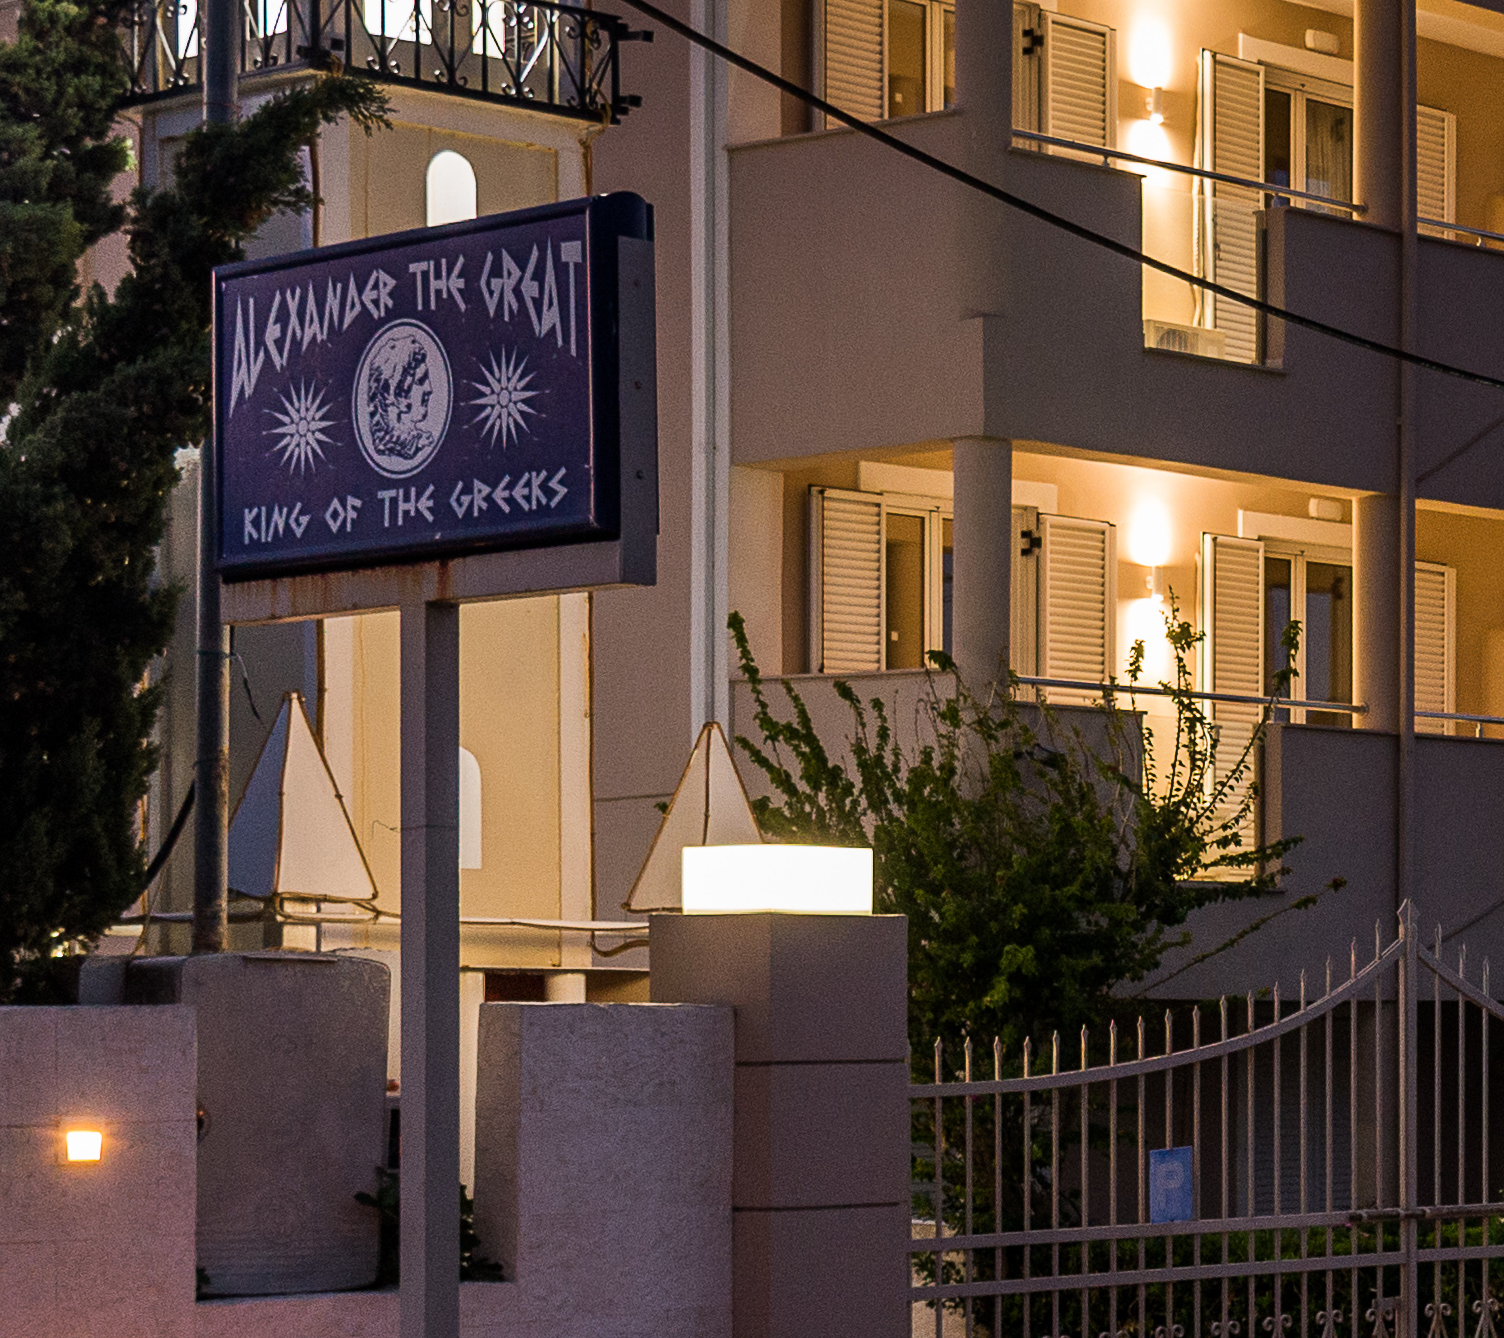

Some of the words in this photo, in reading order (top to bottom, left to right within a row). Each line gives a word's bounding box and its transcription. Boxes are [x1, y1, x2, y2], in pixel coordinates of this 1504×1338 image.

[229, 269, 397, 418] ALEXANDER
[409, 254, 466, 313] THE
[480, 236, 582, 357] GREAT
[244, 501, 311, 545] KING
[324, 495, 362, 534] OF
[377, 484, 436, 528] THE
[449, 467, 568, 519] GREEKS
[1156, 1161, 1185, 1210] P
